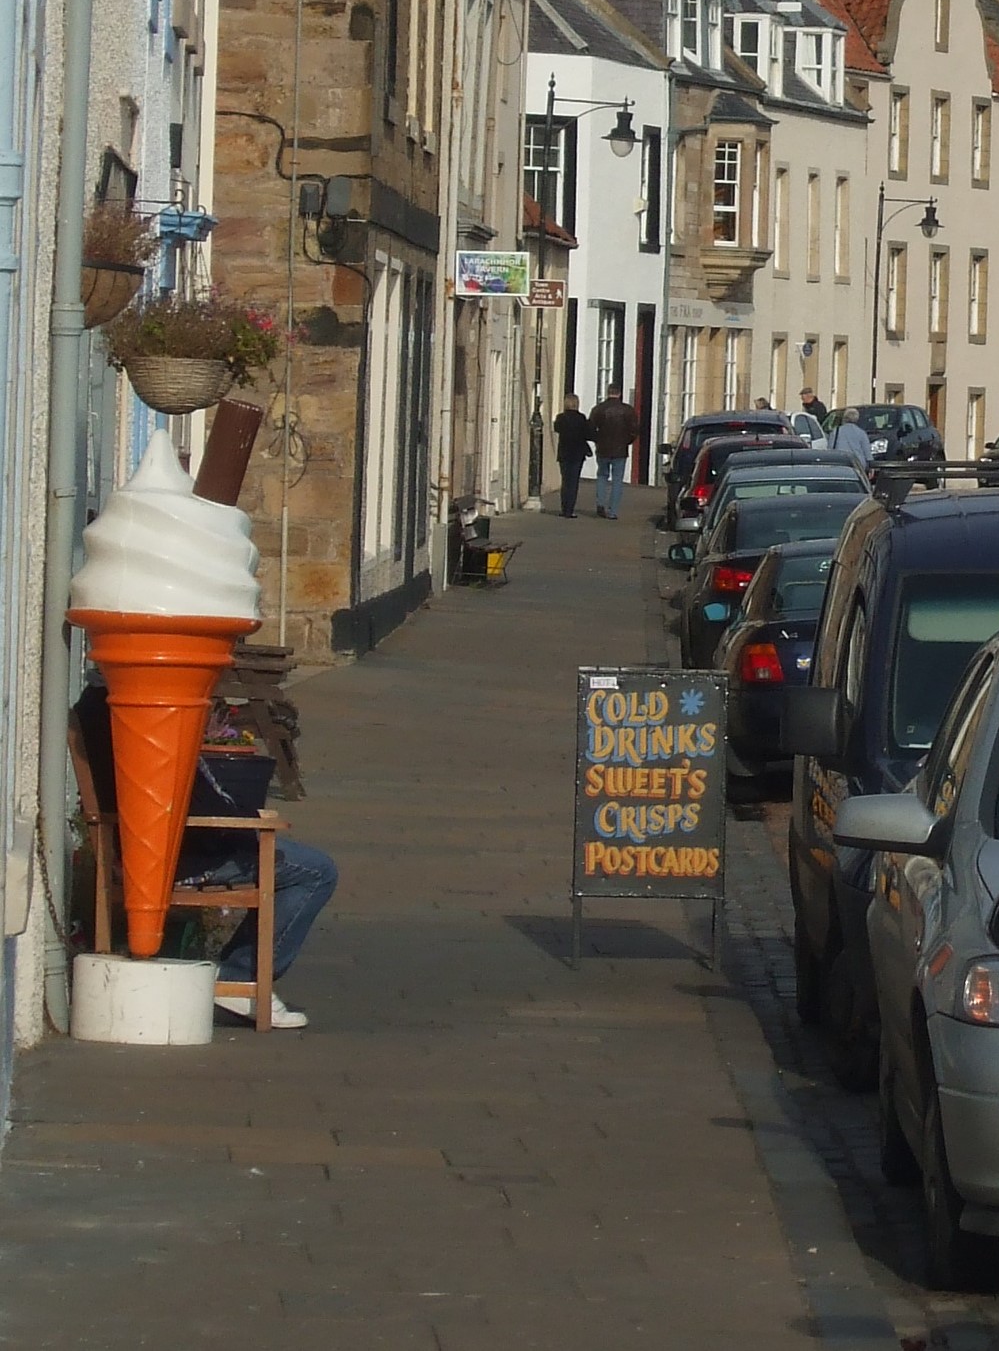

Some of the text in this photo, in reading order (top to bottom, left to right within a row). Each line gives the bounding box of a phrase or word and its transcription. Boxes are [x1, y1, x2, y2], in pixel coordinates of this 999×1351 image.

[475, 265, 510, 273] TAVERN
[586, 689, 669, 726] COLD
[585, 721, 717, 767] DRINKS
[594, 801, 701, 843] CRISPS
[584, 841, 720, 877] POSTCARDS
